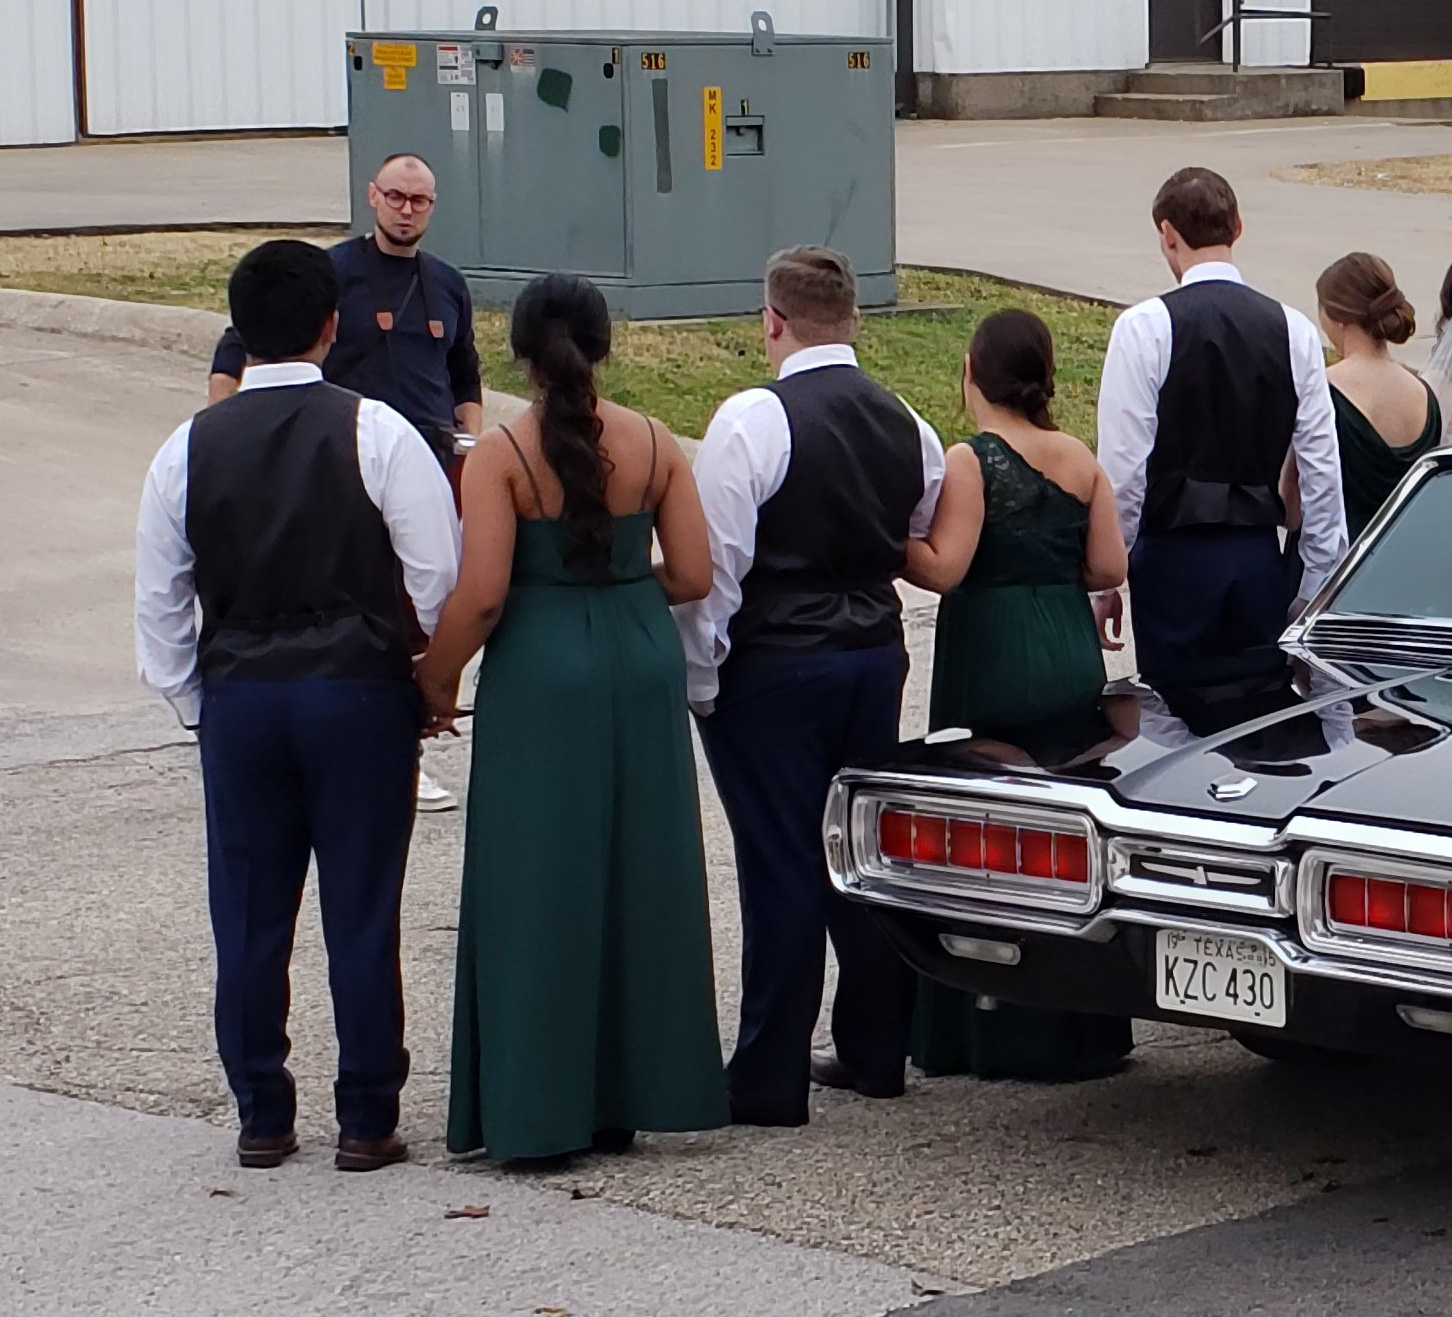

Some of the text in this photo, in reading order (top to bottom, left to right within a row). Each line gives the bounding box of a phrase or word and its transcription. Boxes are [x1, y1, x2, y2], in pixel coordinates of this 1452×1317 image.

[642, 53, 665, 69] 516
[848, 52, 869, 69] 516
[708, 90, 717, 166] MK 232
[1194, 936, 1245, 961] TEXAS
[1164, 955, 1274, 1010] KZC 430
